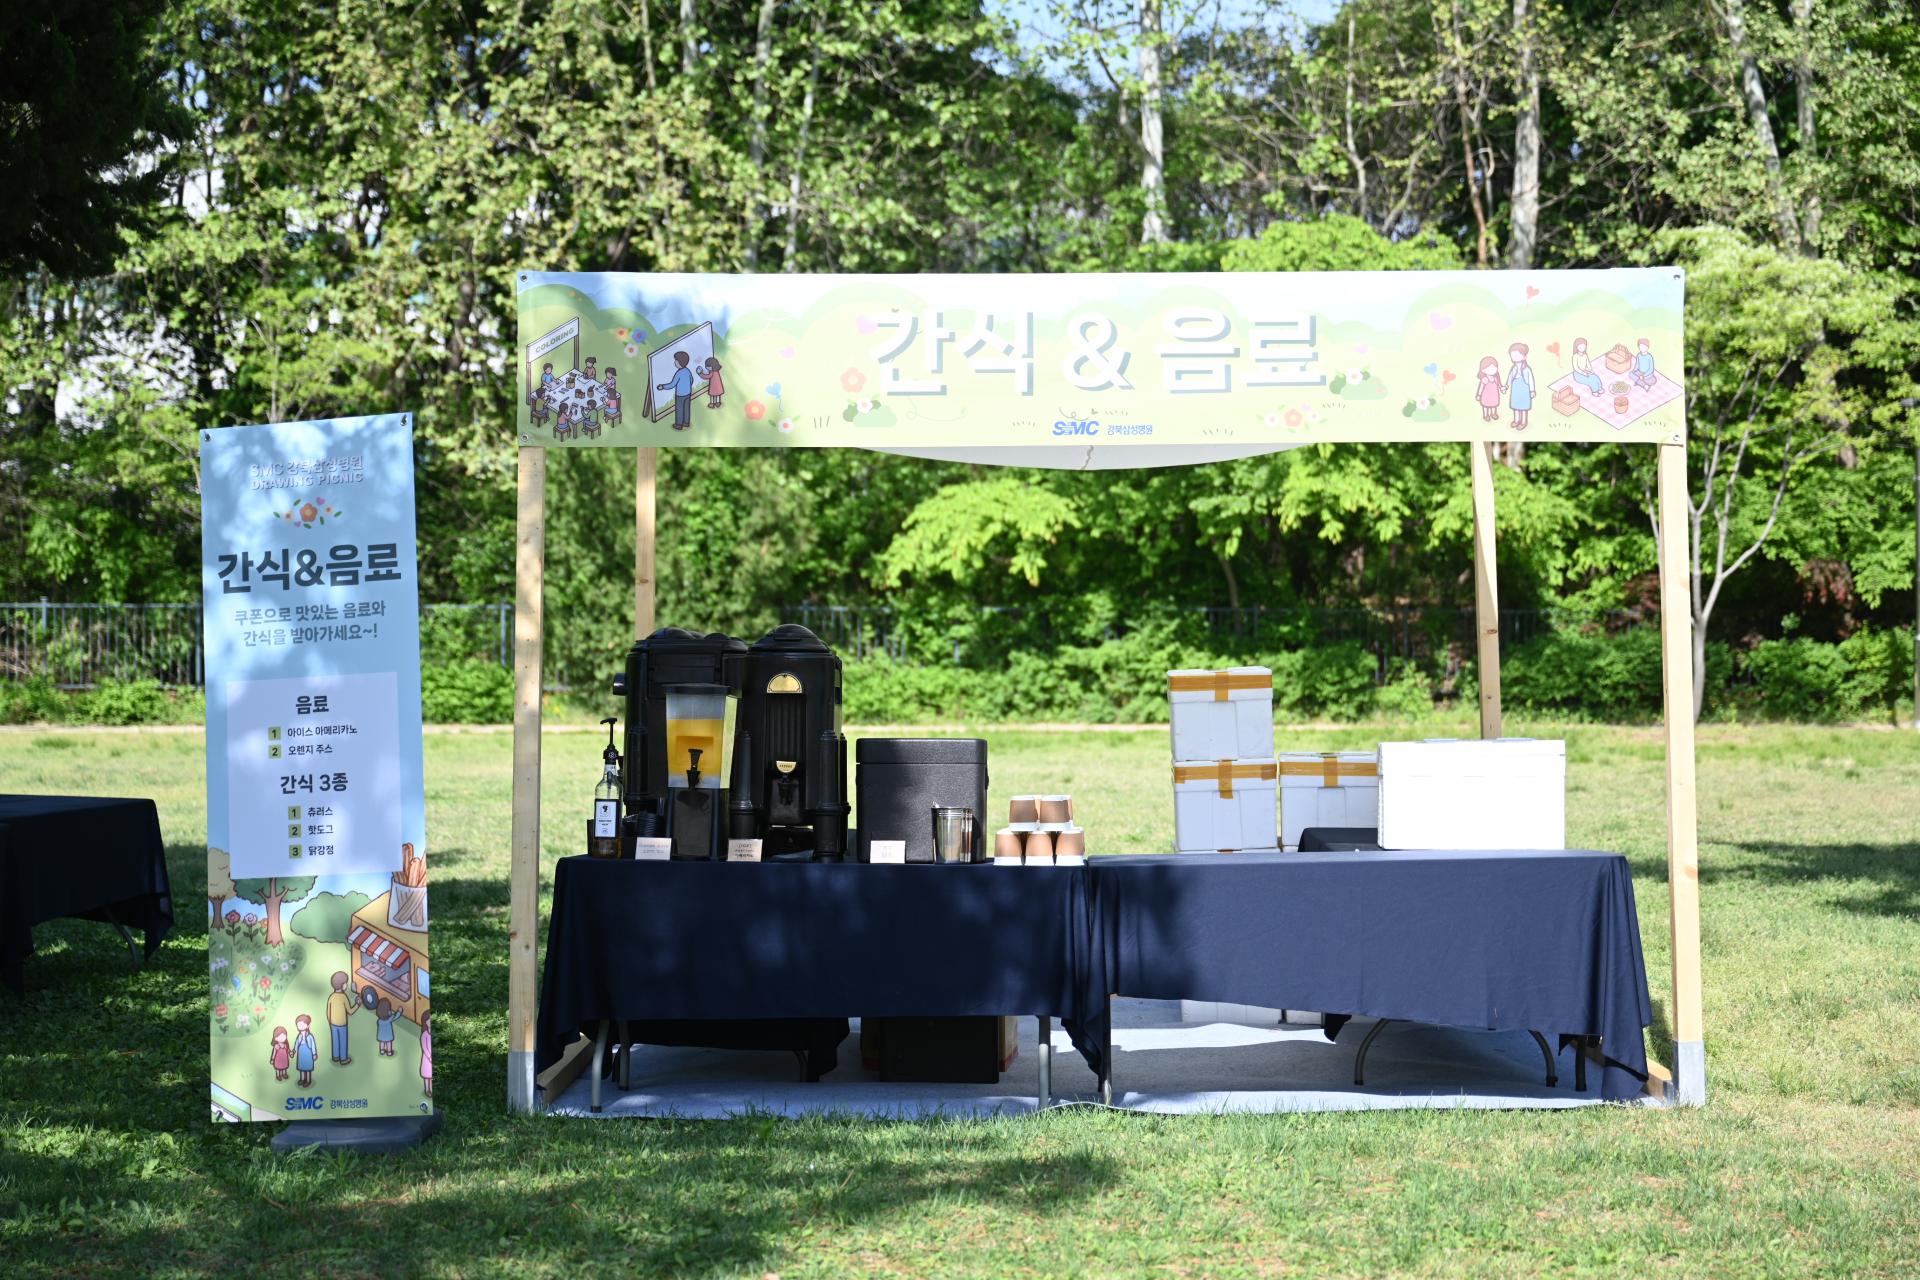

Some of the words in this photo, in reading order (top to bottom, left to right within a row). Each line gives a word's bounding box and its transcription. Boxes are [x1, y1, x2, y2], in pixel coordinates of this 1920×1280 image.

[535, 327, 574, 352] COLORING
[869, 307, 1034, 396] 간식
[1062, 313, 1135, 392] &
[1154, 307, 1328, 394] 음료
[1107, 424, 1153, 435] 강북삼성병원
[250, 463, 284, 477] SMC
[287, 455, 363, 475] 강북삼성병원
[251, 474, 313, 490] DRAWING
[318, 472, 363, 486] PICNIC
[218, 543, 401, 593] 간식&음료
[235, 607, 291, 626] 쿠폰으로
[295, 604, 339, 622] 맛있는
[343, 600, 386, 618] 음료와
[243, 628, 286, 647] 간식을
[290, 623, 378, 645] 받아가세요~!
[295, 695, 329, 715] 음료
[287, 727, 313, 738] 아이스
[315, 724, 358, 737] 아메리카노
[288, 745, 314, 756] 오렌지
[316, 744, 333, 755] 주스
[280, 774, 313, 795] 간식
[319, 772, 348, 792] 3종
[308, 806, 333, 817] 츄러스
[308, 825, 334, 836] 핫도그
[308, 845, 334, 856] 닭강정
[330, 1099, 368, 1110] 강북삼성병원
